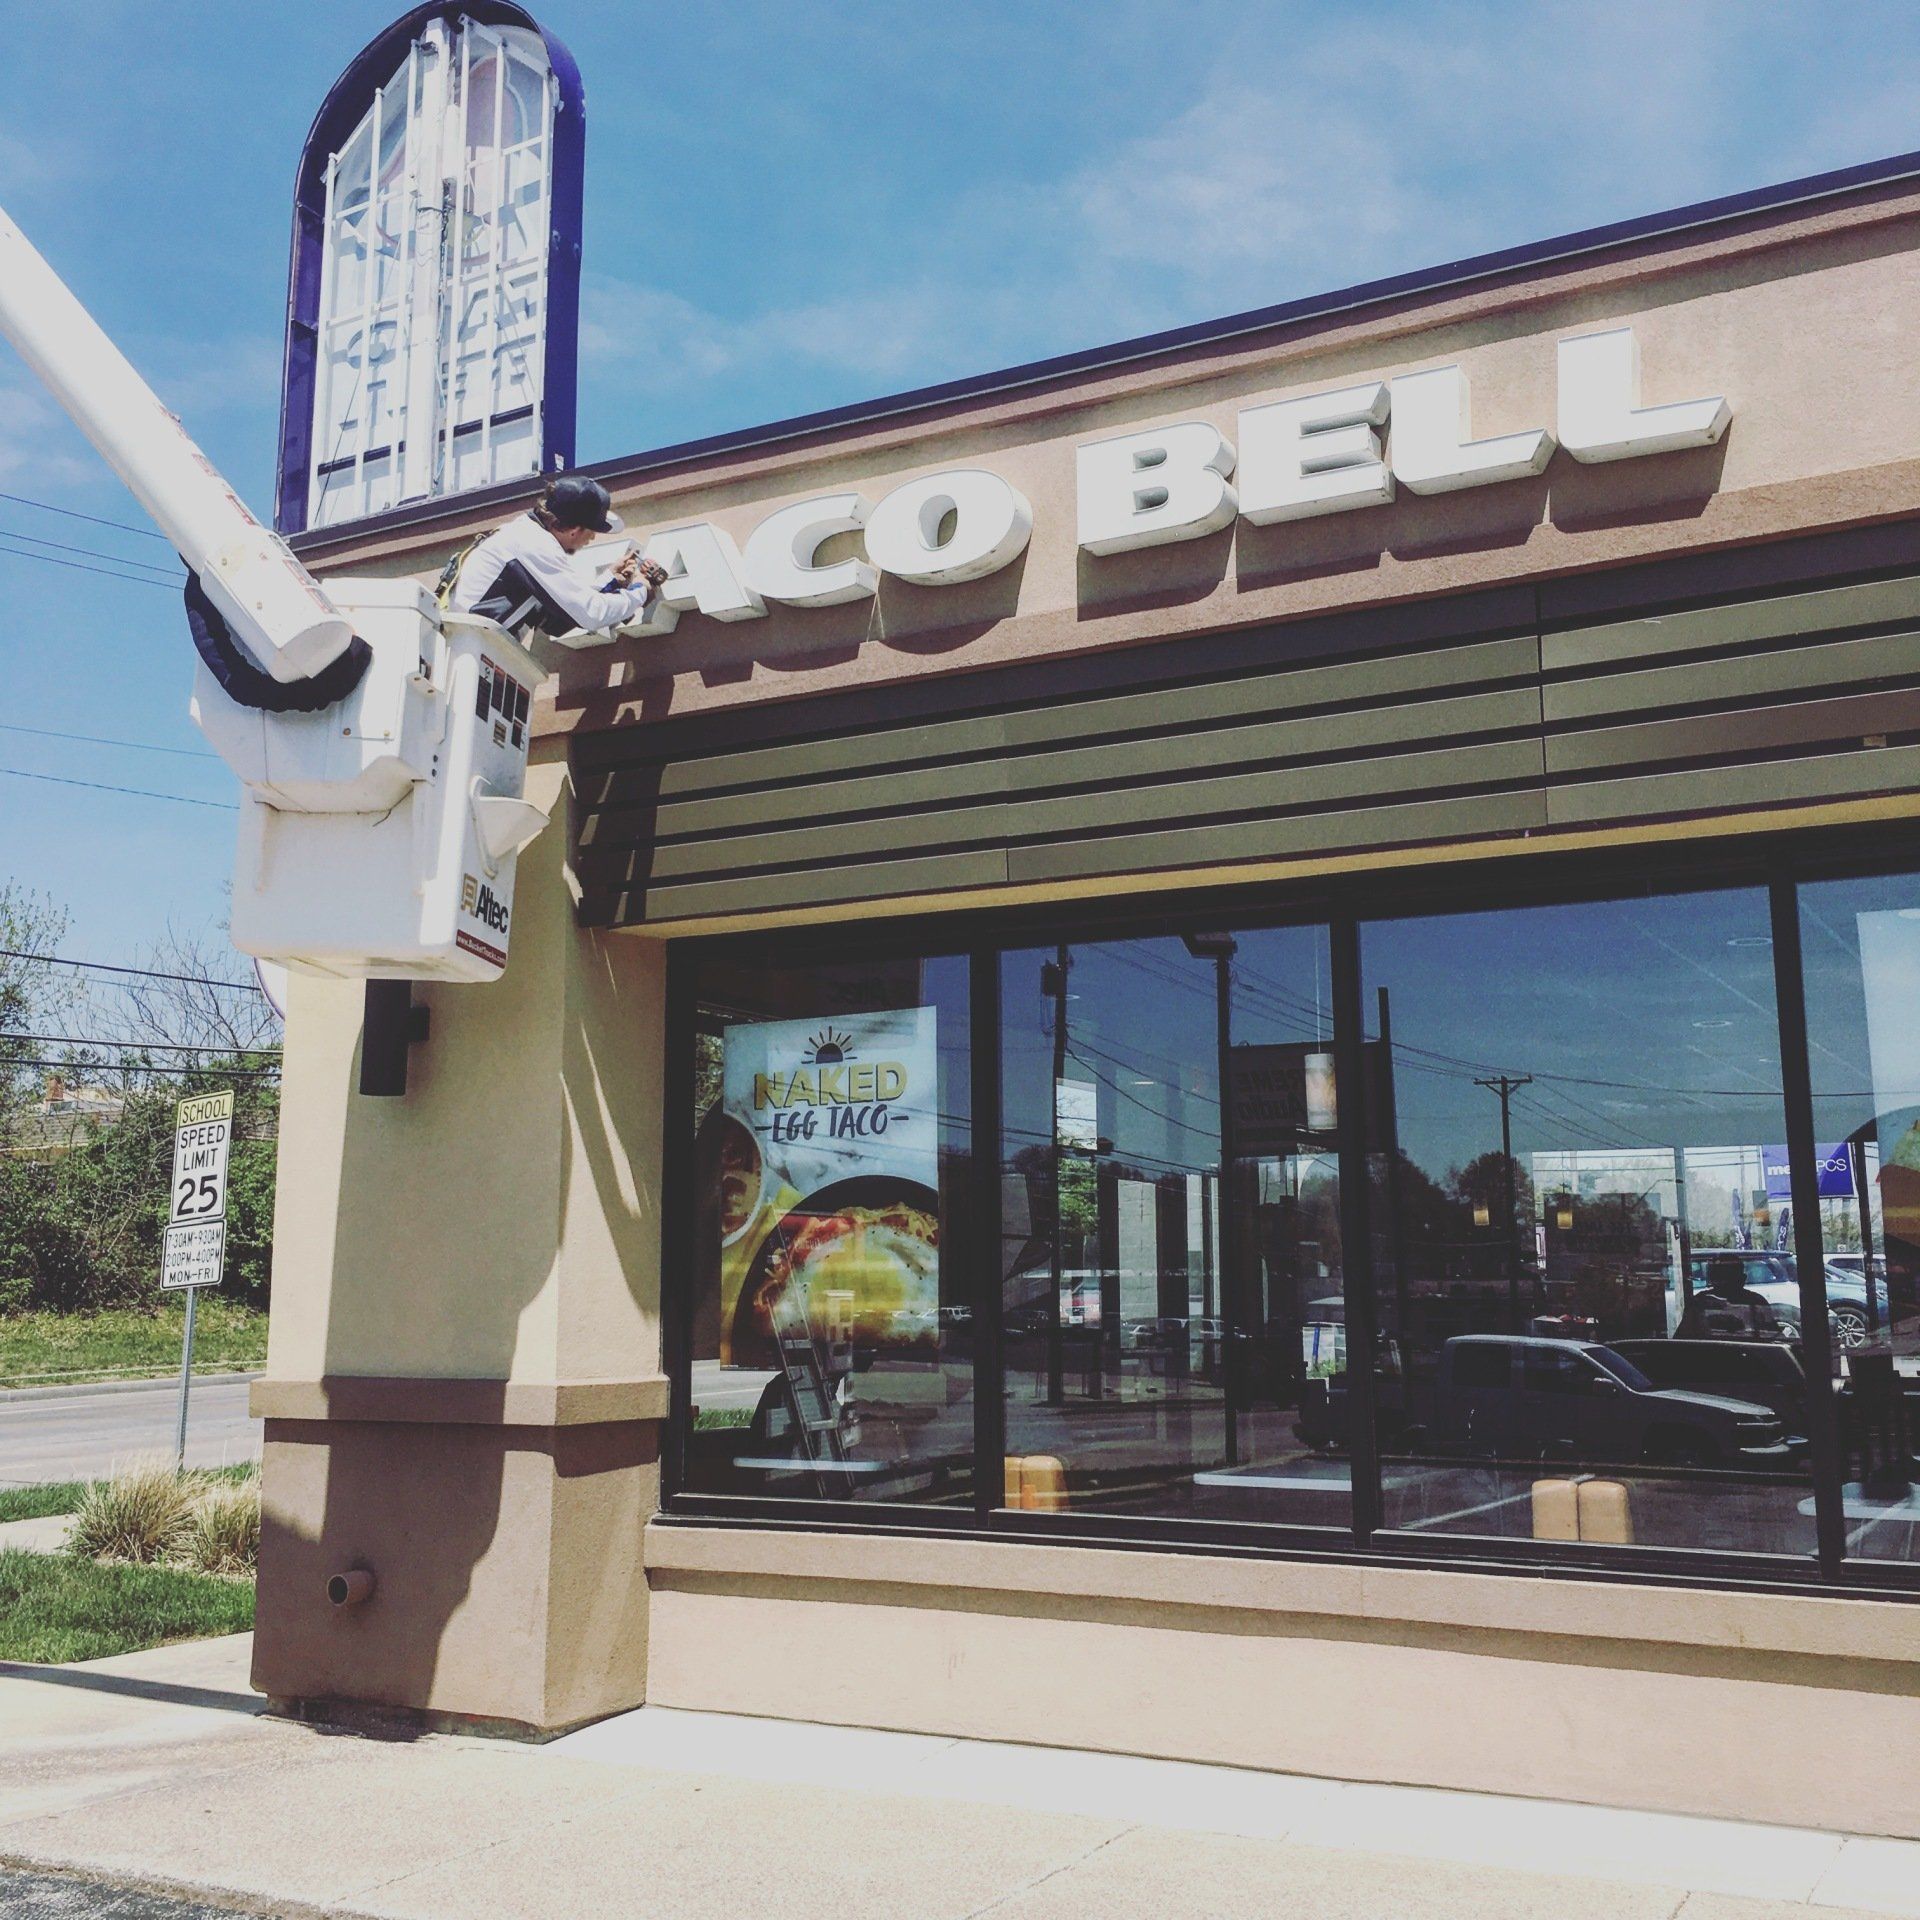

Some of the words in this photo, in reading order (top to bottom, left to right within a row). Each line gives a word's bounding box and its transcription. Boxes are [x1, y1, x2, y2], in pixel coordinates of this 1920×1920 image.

[1076, 326, 1731, 556] BELL
[475, 884, 509, 933] Altec
[754, 1061, 908, 1110] NAKED
[182, 1098, 228, 1124] SCHOOL
[181, 1125, 225, 1149] SPEED
[183, 1148, 218, 1171] LIMIT
[177, 1175, 218, 1216] 25
[168, 1267, 214, 1284] MON-FRI
